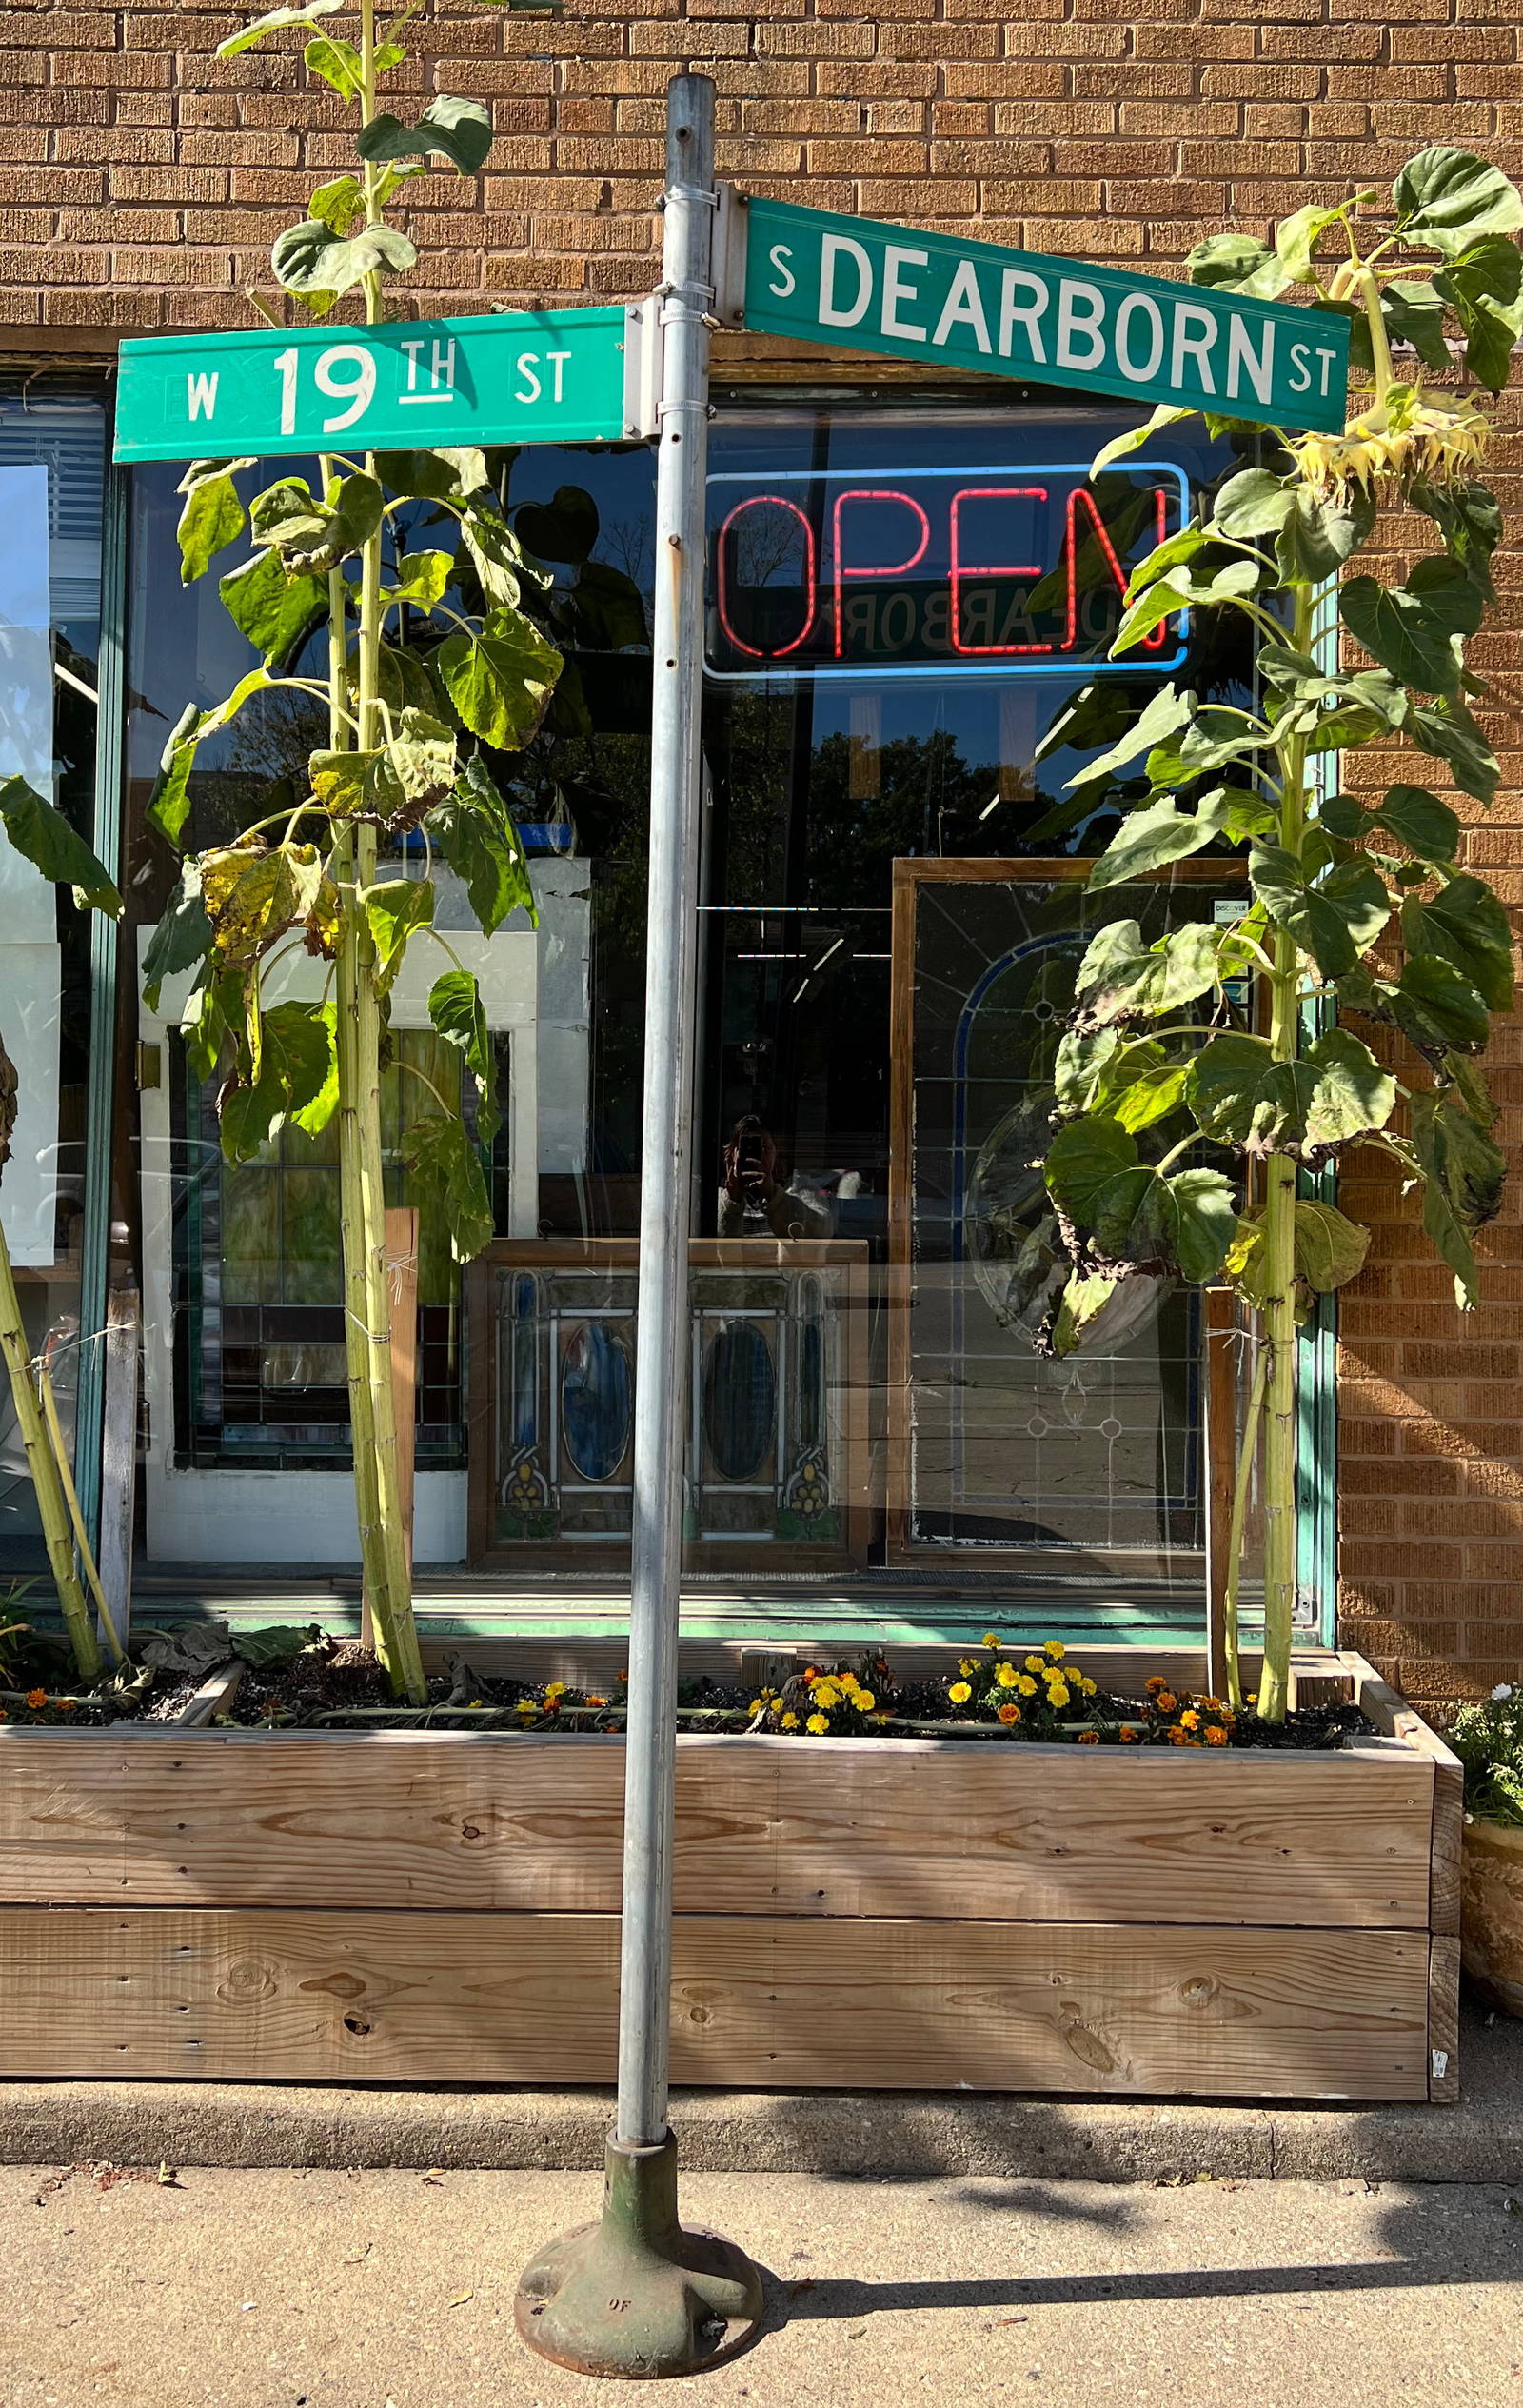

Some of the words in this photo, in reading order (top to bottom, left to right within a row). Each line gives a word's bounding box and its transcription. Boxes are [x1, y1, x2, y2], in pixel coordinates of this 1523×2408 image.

[187, 372, 219, 421] W
[515, 351, 571, 404] ST
[769, 244, 795, 297] S
[819, 233, 1276, 405] DEARBORN
[1288, 343, 1336, 396] ST
[718, 488, 1167, 659] OPEN
